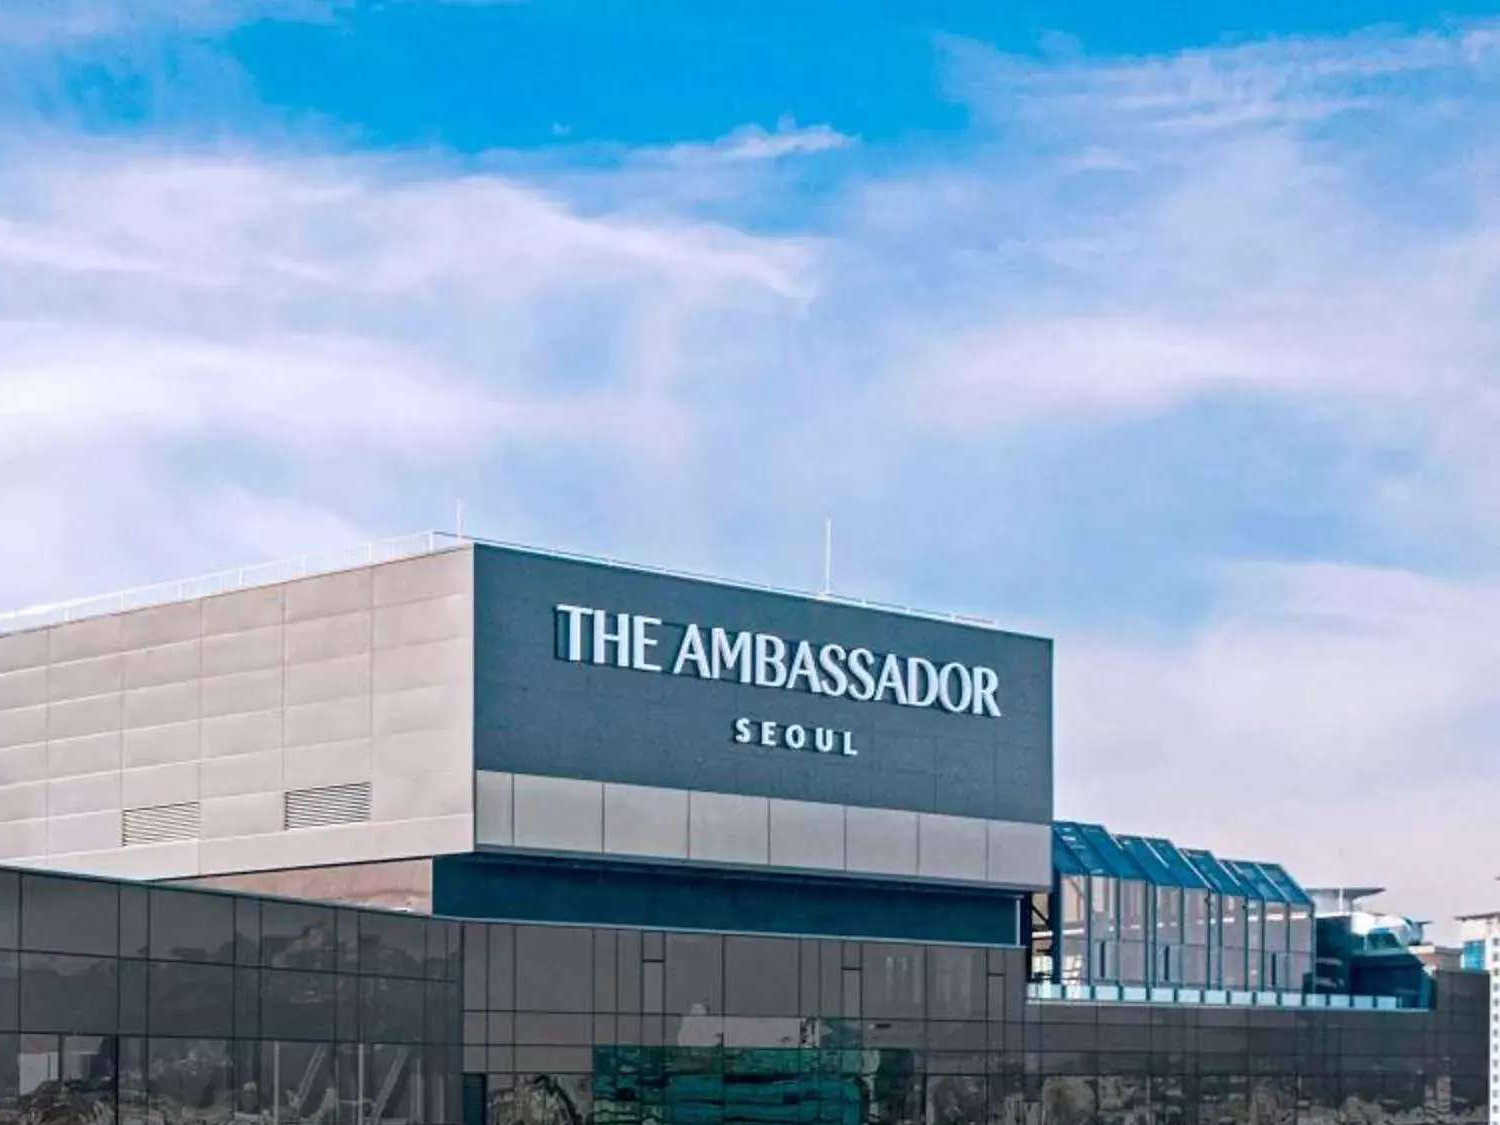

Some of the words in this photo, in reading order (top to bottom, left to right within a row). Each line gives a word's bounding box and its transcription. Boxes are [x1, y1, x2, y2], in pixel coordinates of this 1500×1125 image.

[557, 604, 662, 671] THE
[673, 624, 1001, 717] AMBASSADOR
[735, 717, 858, 756] SEOUL
